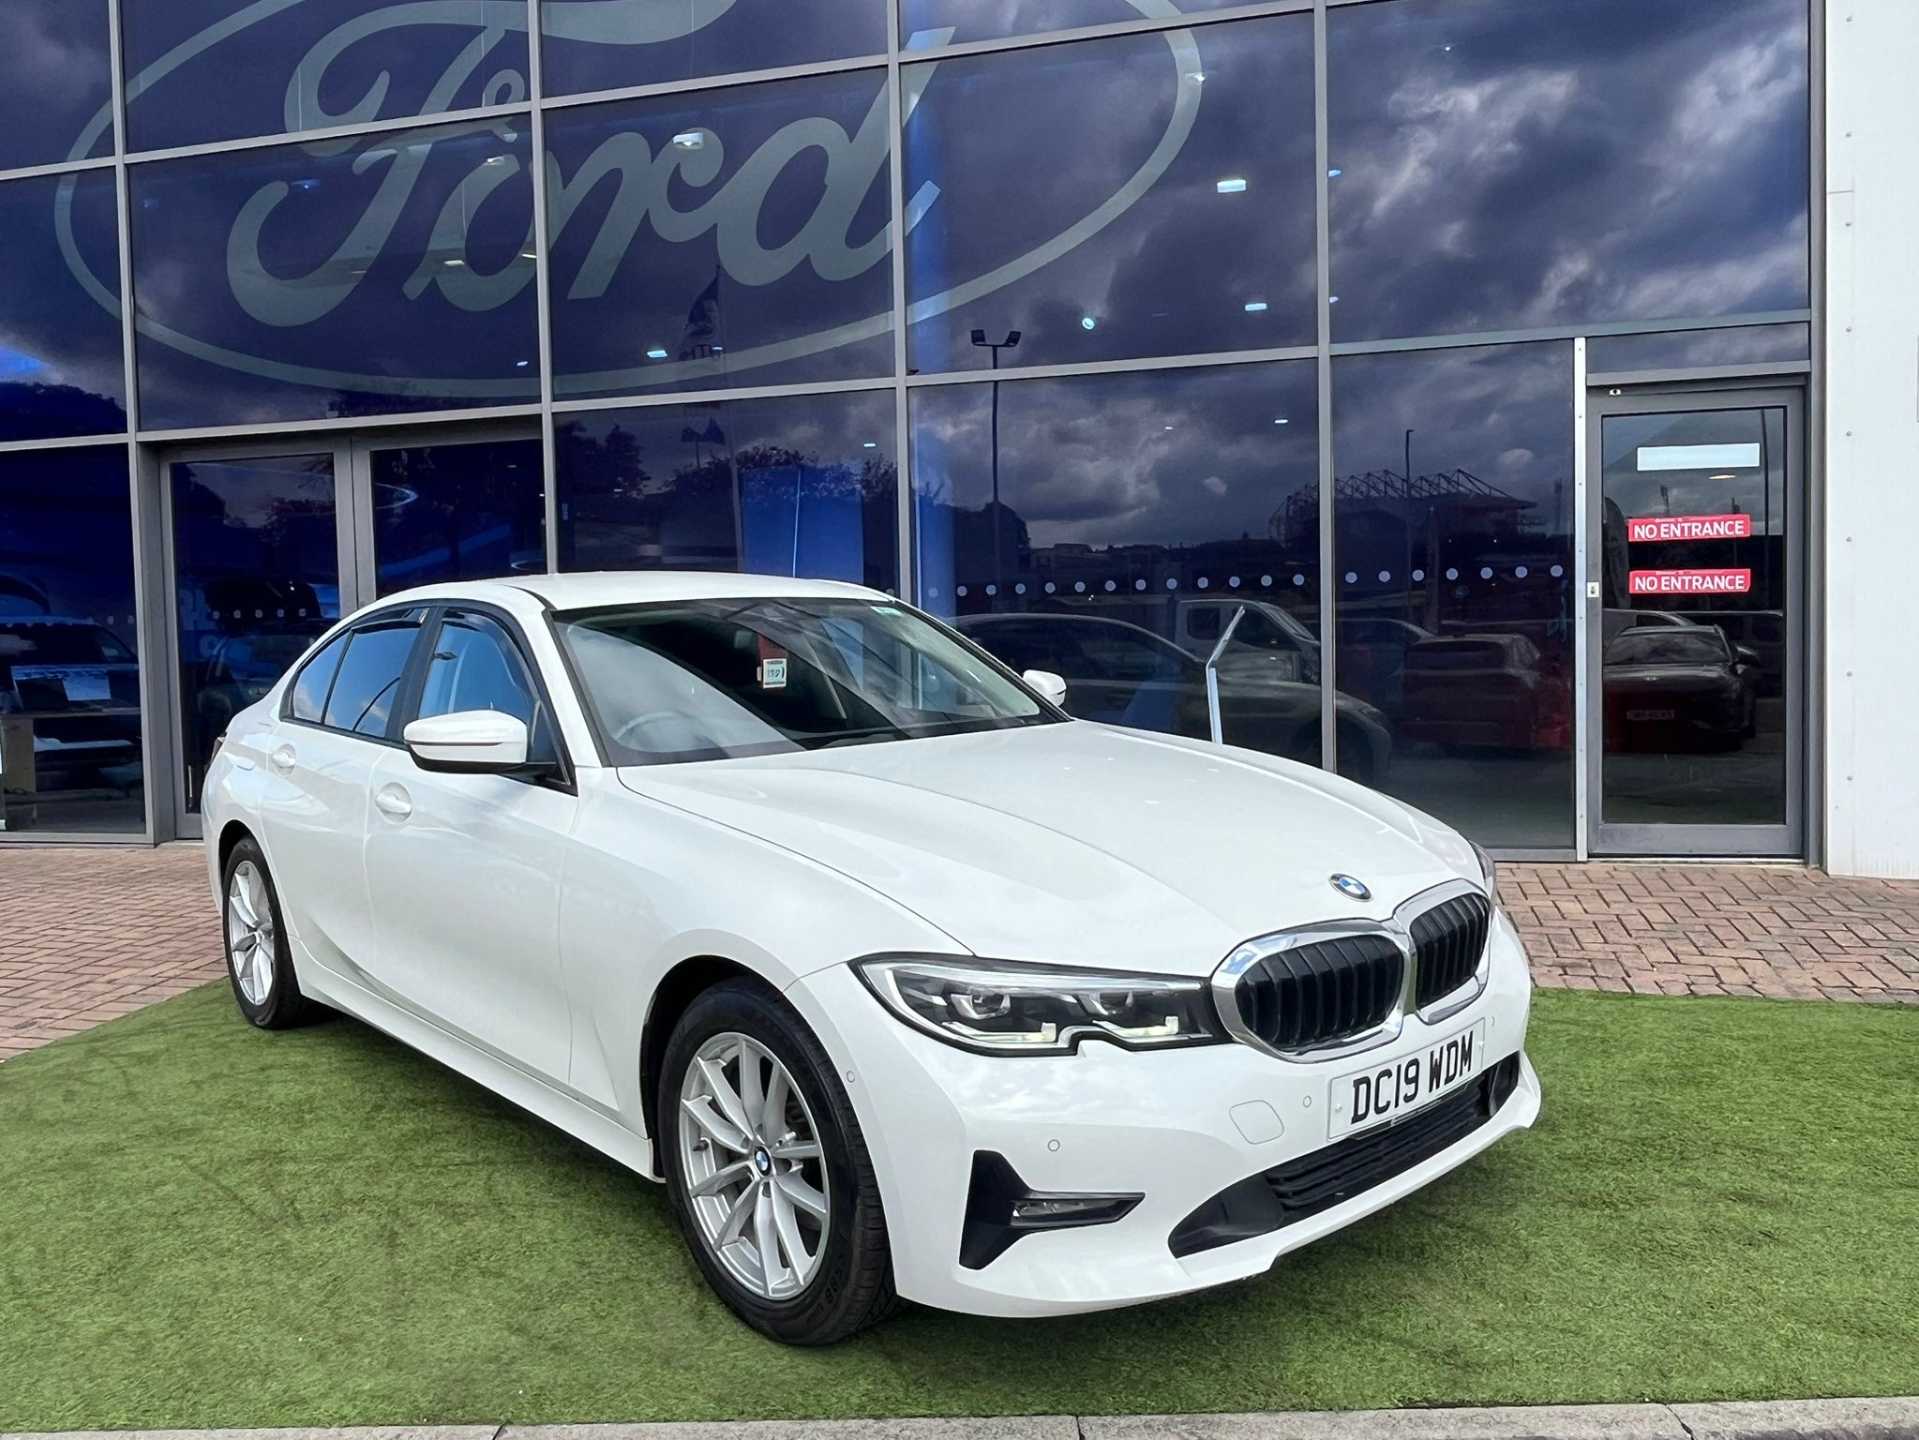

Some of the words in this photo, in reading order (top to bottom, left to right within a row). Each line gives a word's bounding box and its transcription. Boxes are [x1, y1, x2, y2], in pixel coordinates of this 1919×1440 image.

[228, 0, 955, 327] Ford
[1634, 525, 1657, 538] NO
[1660, 521, 1744, 537] ENTRANCE
[1635, 577, 1657, 590] NO
[1661, 576, 1744, 590] ENTRANCE
[1351, 1058, 1420, 1124] DC19
[1429, 1031, 1473, 1093] WDM
